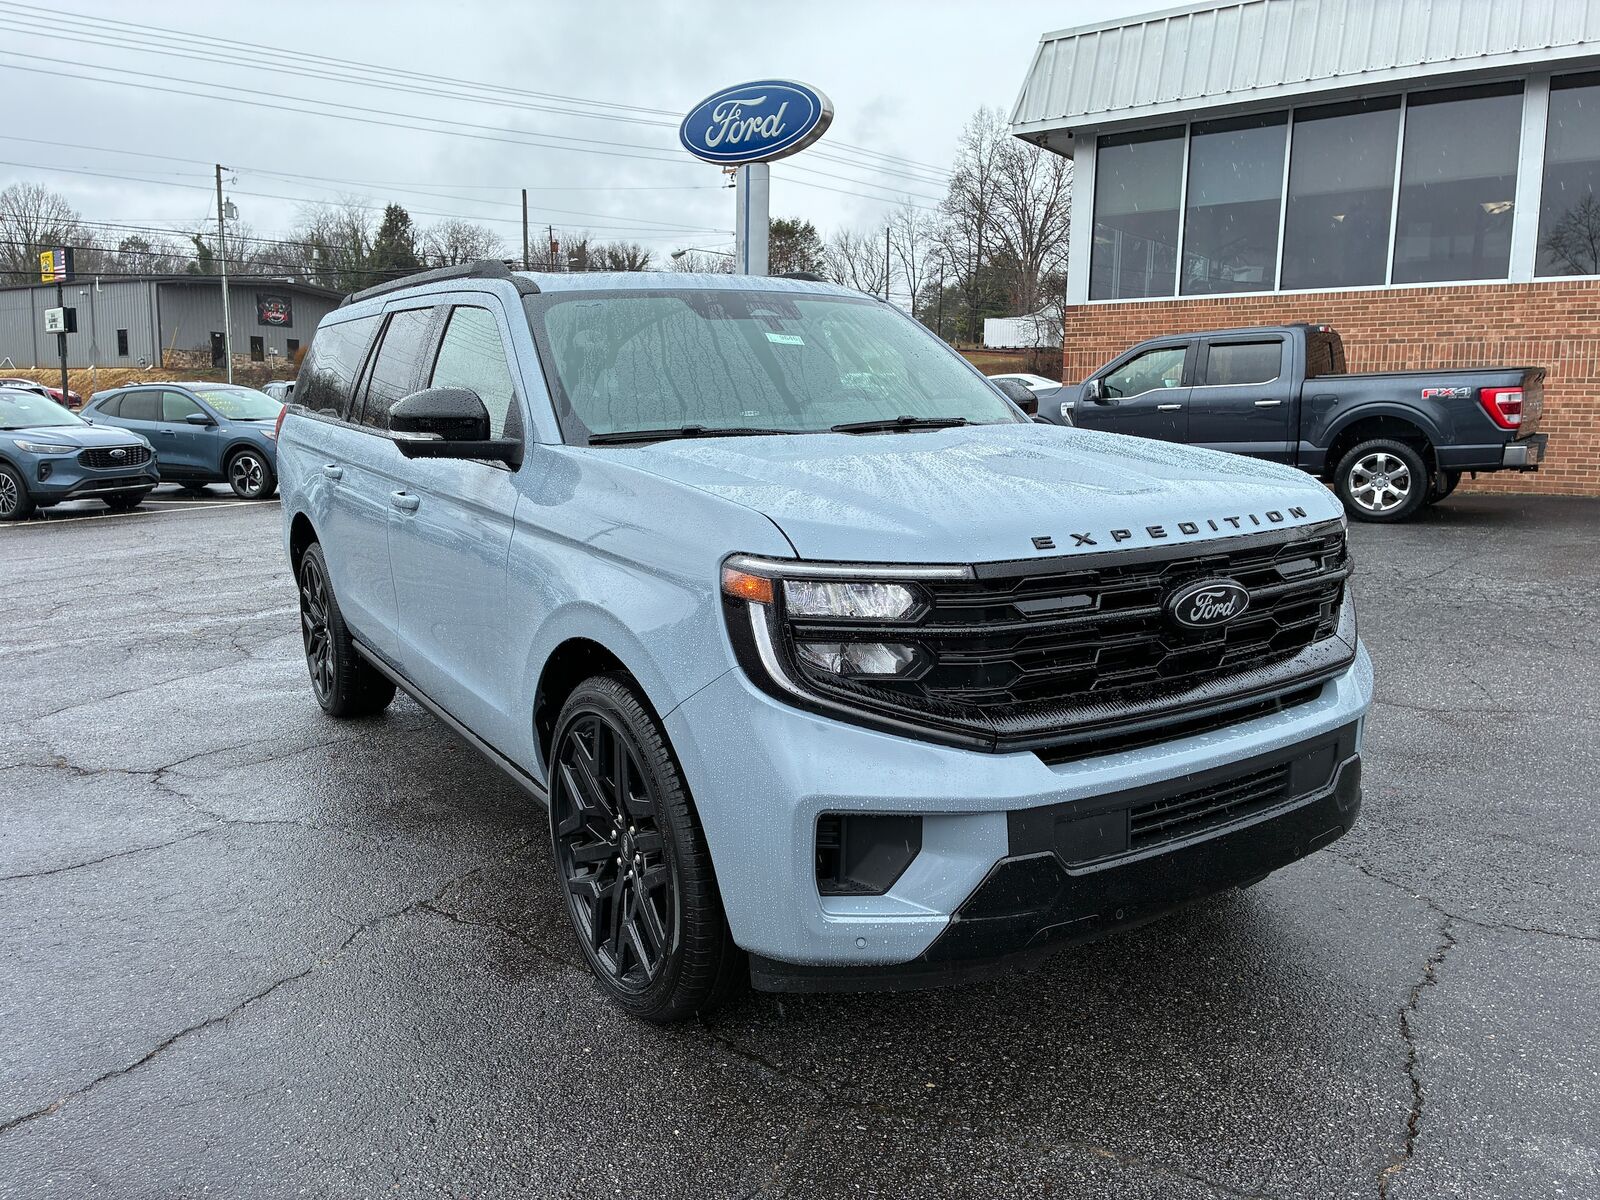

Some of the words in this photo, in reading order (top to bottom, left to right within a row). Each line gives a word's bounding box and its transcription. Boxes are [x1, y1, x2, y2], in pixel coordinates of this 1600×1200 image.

[704, 95, 789, 148] Ford
[1421, 387, 1471, 400] FX4
[1031, 506, 1308, 550] EXPEDITION
[1190, 590, 1237, 622] Ford
